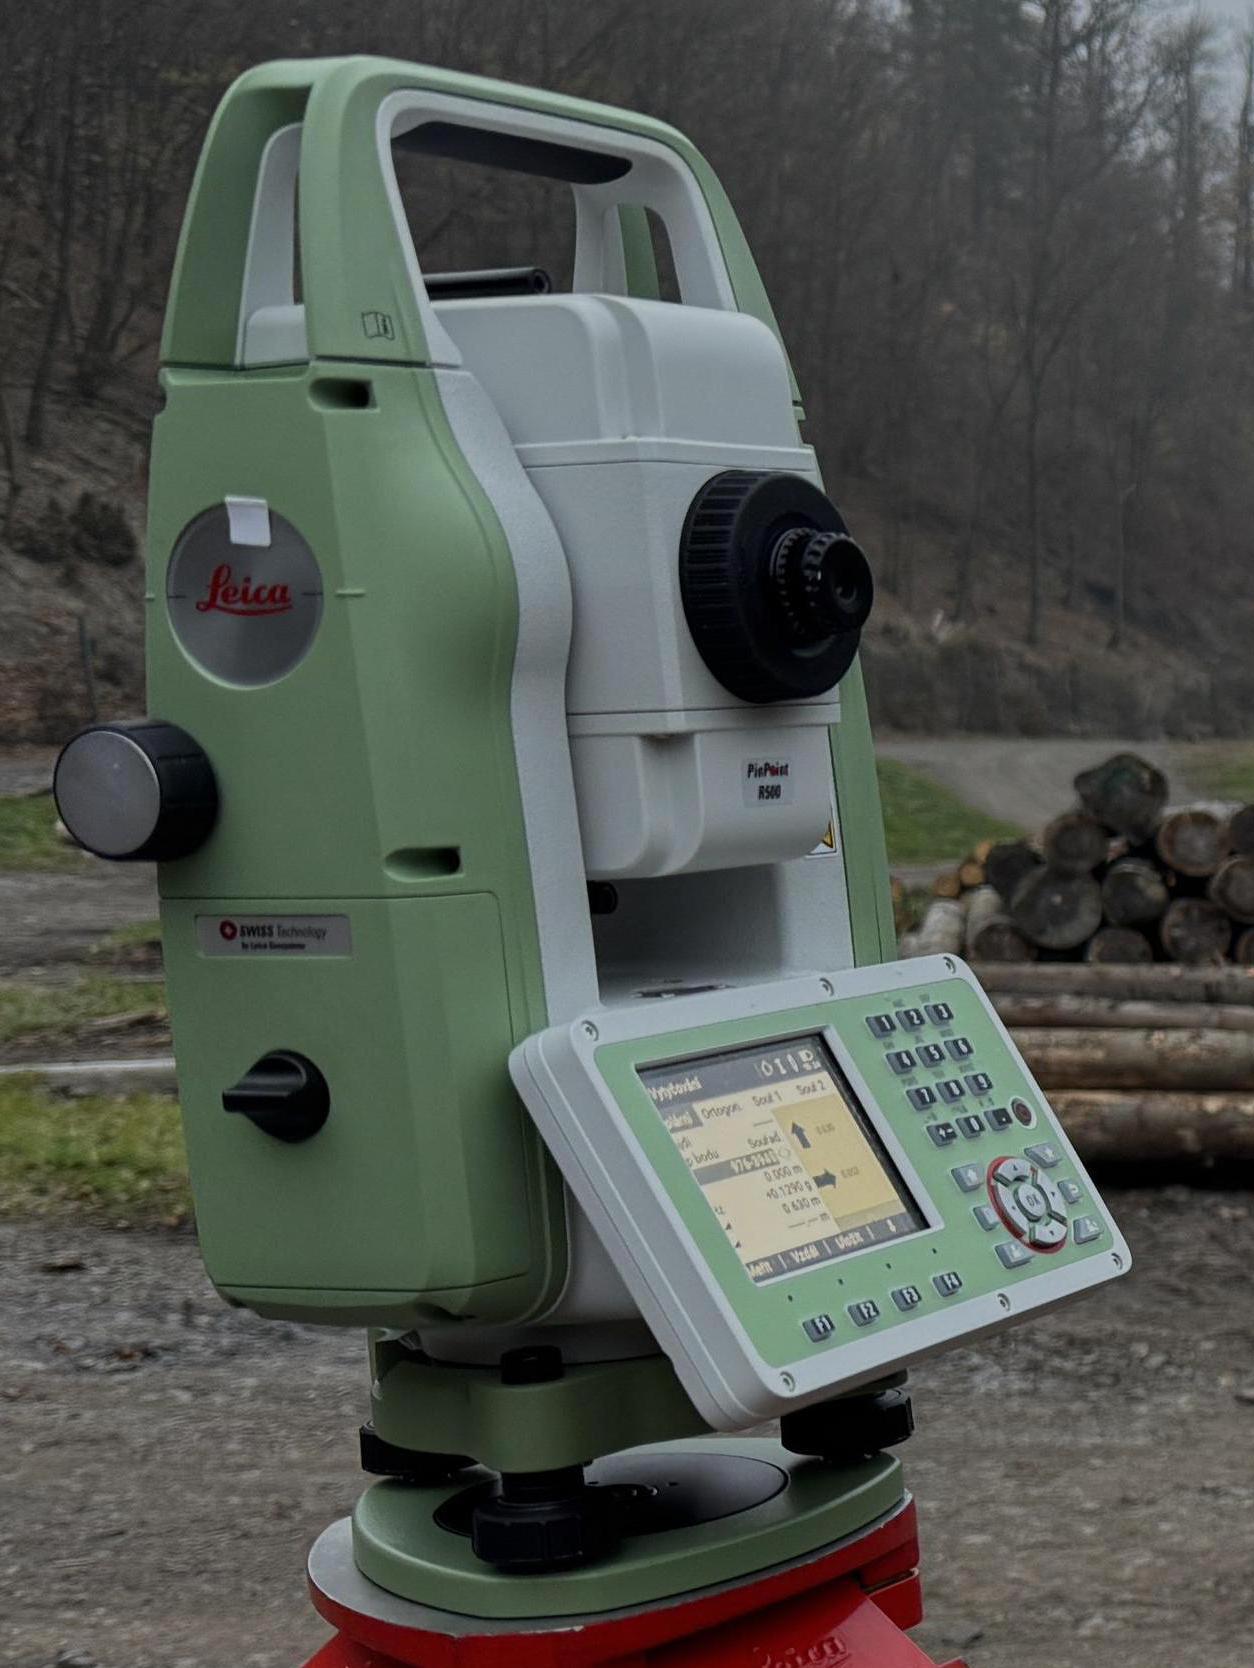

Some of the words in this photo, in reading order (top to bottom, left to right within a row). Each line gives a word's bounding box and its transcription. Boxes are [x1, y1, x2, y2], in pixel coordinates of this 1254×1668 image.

[196, 563, 293, 616] Leica
[747, 761, 789, 778] PinPoint
[758, 785, 782, 800] R500
[240, 925, 274, 938] SWISS
[276, 925, 327, 940] Technology
[909, 1010, 920, 1024] 2
[938, 1005, 949, 1018] 3
[929, 1046, 940, 1060] 5
[957, 1039, 968, 1053] 6
[901, 1053, 911, 1066] 4
[949, 1082, 960, 1095] 8
[977, 1075, 987, 1088] 9
[920, 1088, 930, 1102] 7
[970, 1117, 980, 1131] 0
[1025, 1194, 1042, 1207] OK
[943, 1274, 960, 1290] F4
[902, 1288, 919, 1304] F3
[860, 1304, 876, 1320] F2
[814, 1317, 831, 1333] F1
